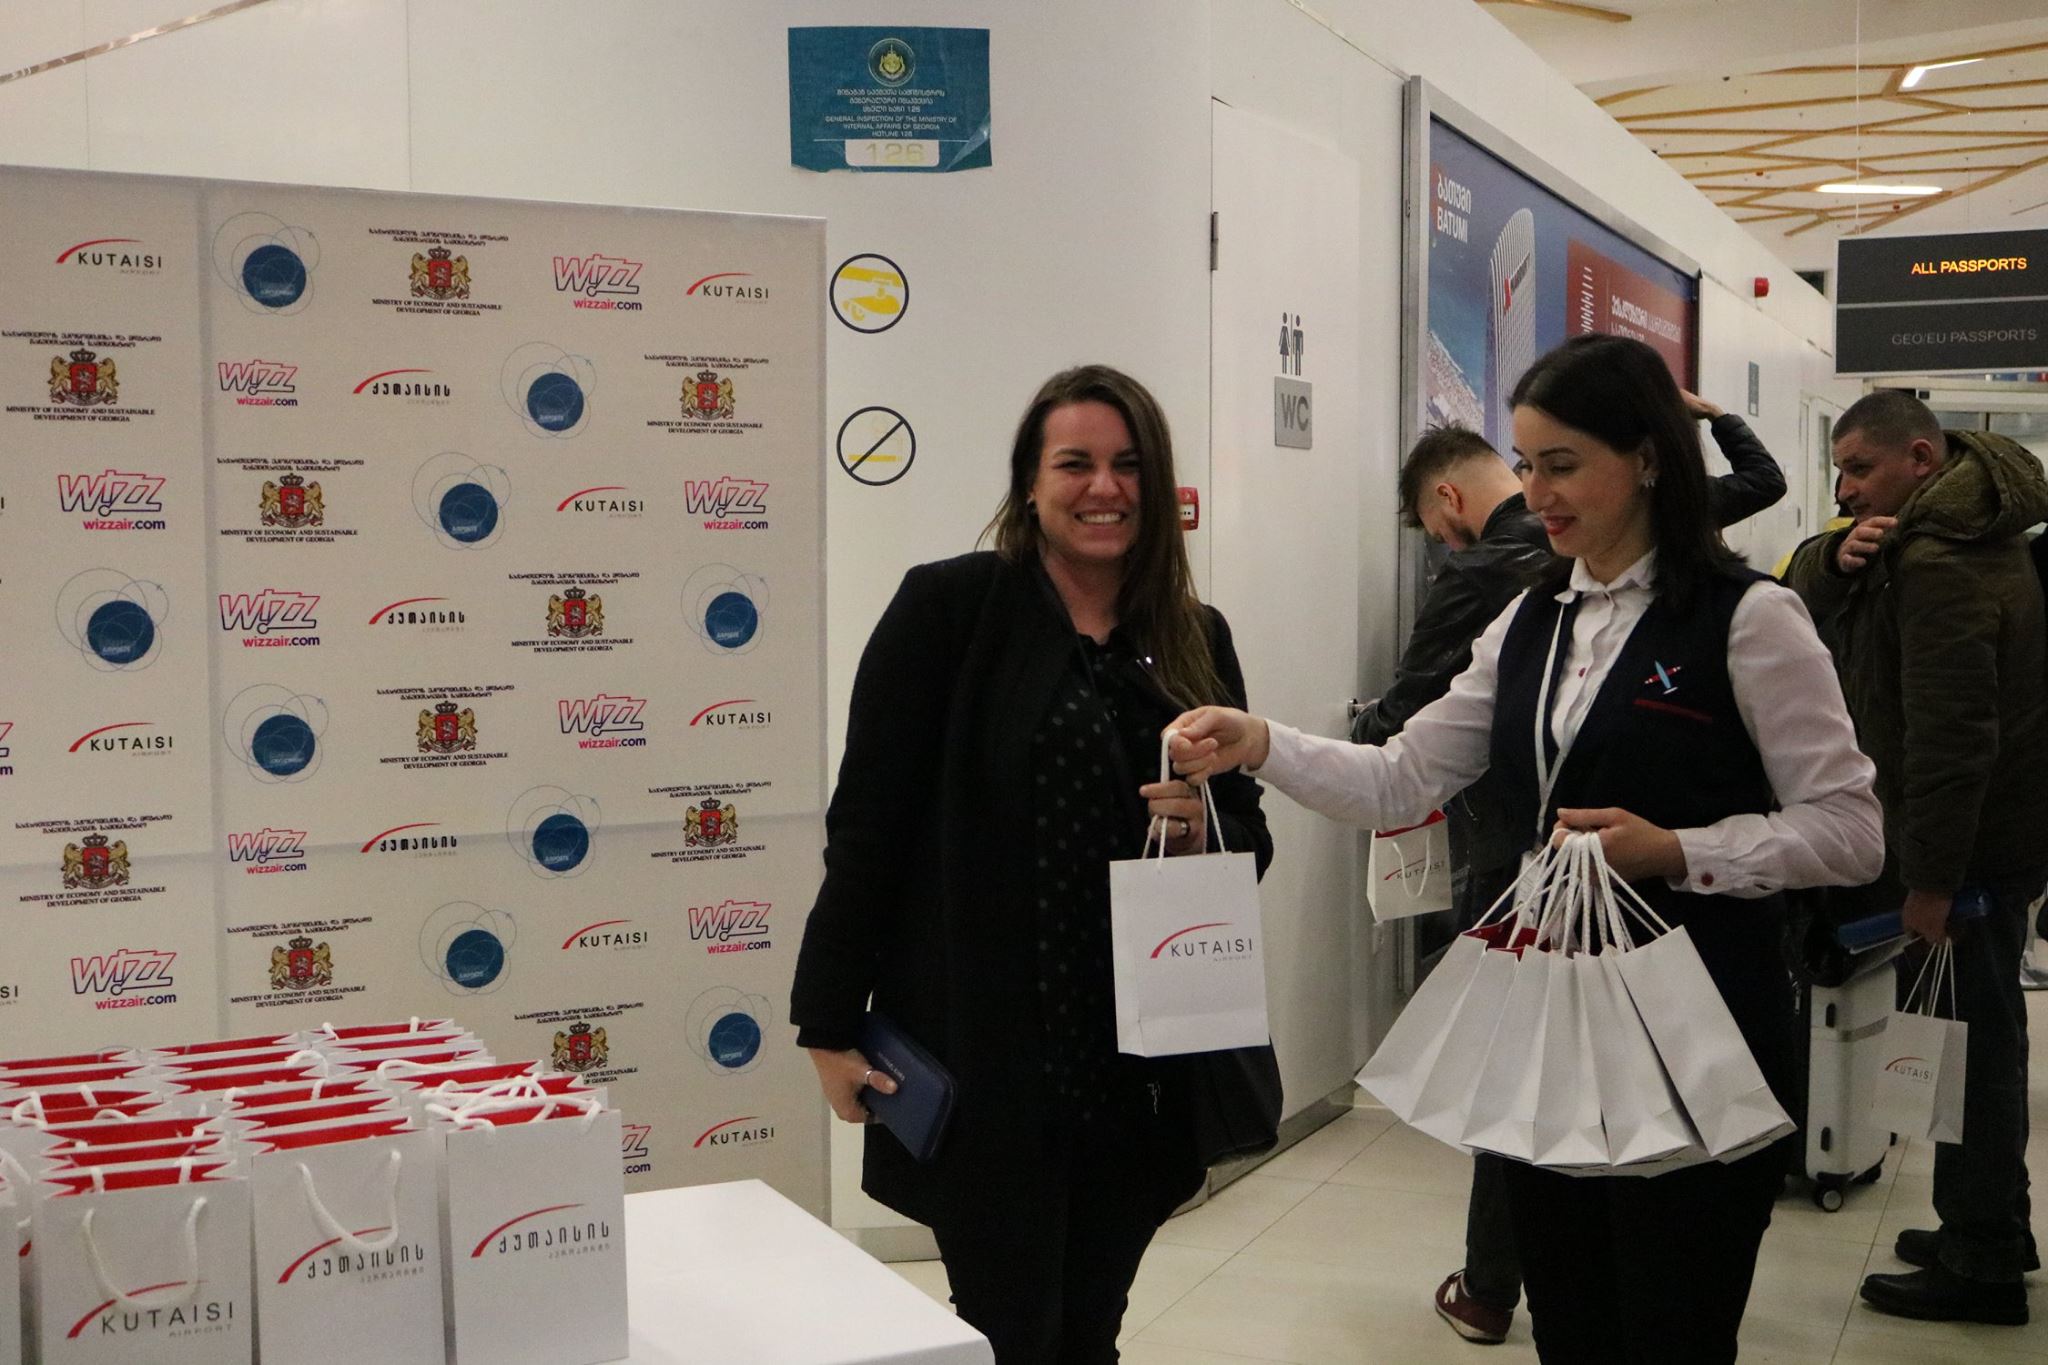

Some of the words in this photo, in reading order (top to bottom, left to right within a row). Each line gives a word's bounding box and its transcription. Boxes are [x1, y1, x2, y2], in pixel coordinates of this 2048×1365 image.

[1437, 173, 1472, 214] ბათუმი
[1437, 206, 1468, 243] BATUMI
[78, 252, 162, 268] KUTAISI
[1911, 262, 1937, 275] ALL
[1940, 257, 2027, 273] PASSPORTS
[703, 284, 769, 298] KUTAISI
[573, 298, 642, 311] wizzair.com
[1950, 329, 2037, 343] PASSPORTS
[236, 396, 298, 406] wizzair.com
[1281, 393, 1309, 431] WC
[574, 500, 643, 512] KUTAISI
[83, 518, 165, 530] wizzair.com
[704, 519, 769, 530] wizzair.com
[242, 635, 320, 648] wizzair.com
[706, 712, 771, 725] KUTAISI
[90, 736, 173, 751] KUTAISI
[579, 737, 647, 750] wizzair.com
[246, 863, 307, 874] wizzair.com
[579, 931, 648, 948] KUTAISI
[707, 940, 771, 954] wizzair.com
[1171, 938, 1253, 957] KUTAISI
[95, 993, 177, 1010] wizzair.com
[710, 1127, 774, 1145] KUTAISI
[499, 1221, 609, 1253] ქუთაისის
[308, 1244, 423, 1278] ქუთაისის
[102, 1302, 233, 1335] KUTAISI
